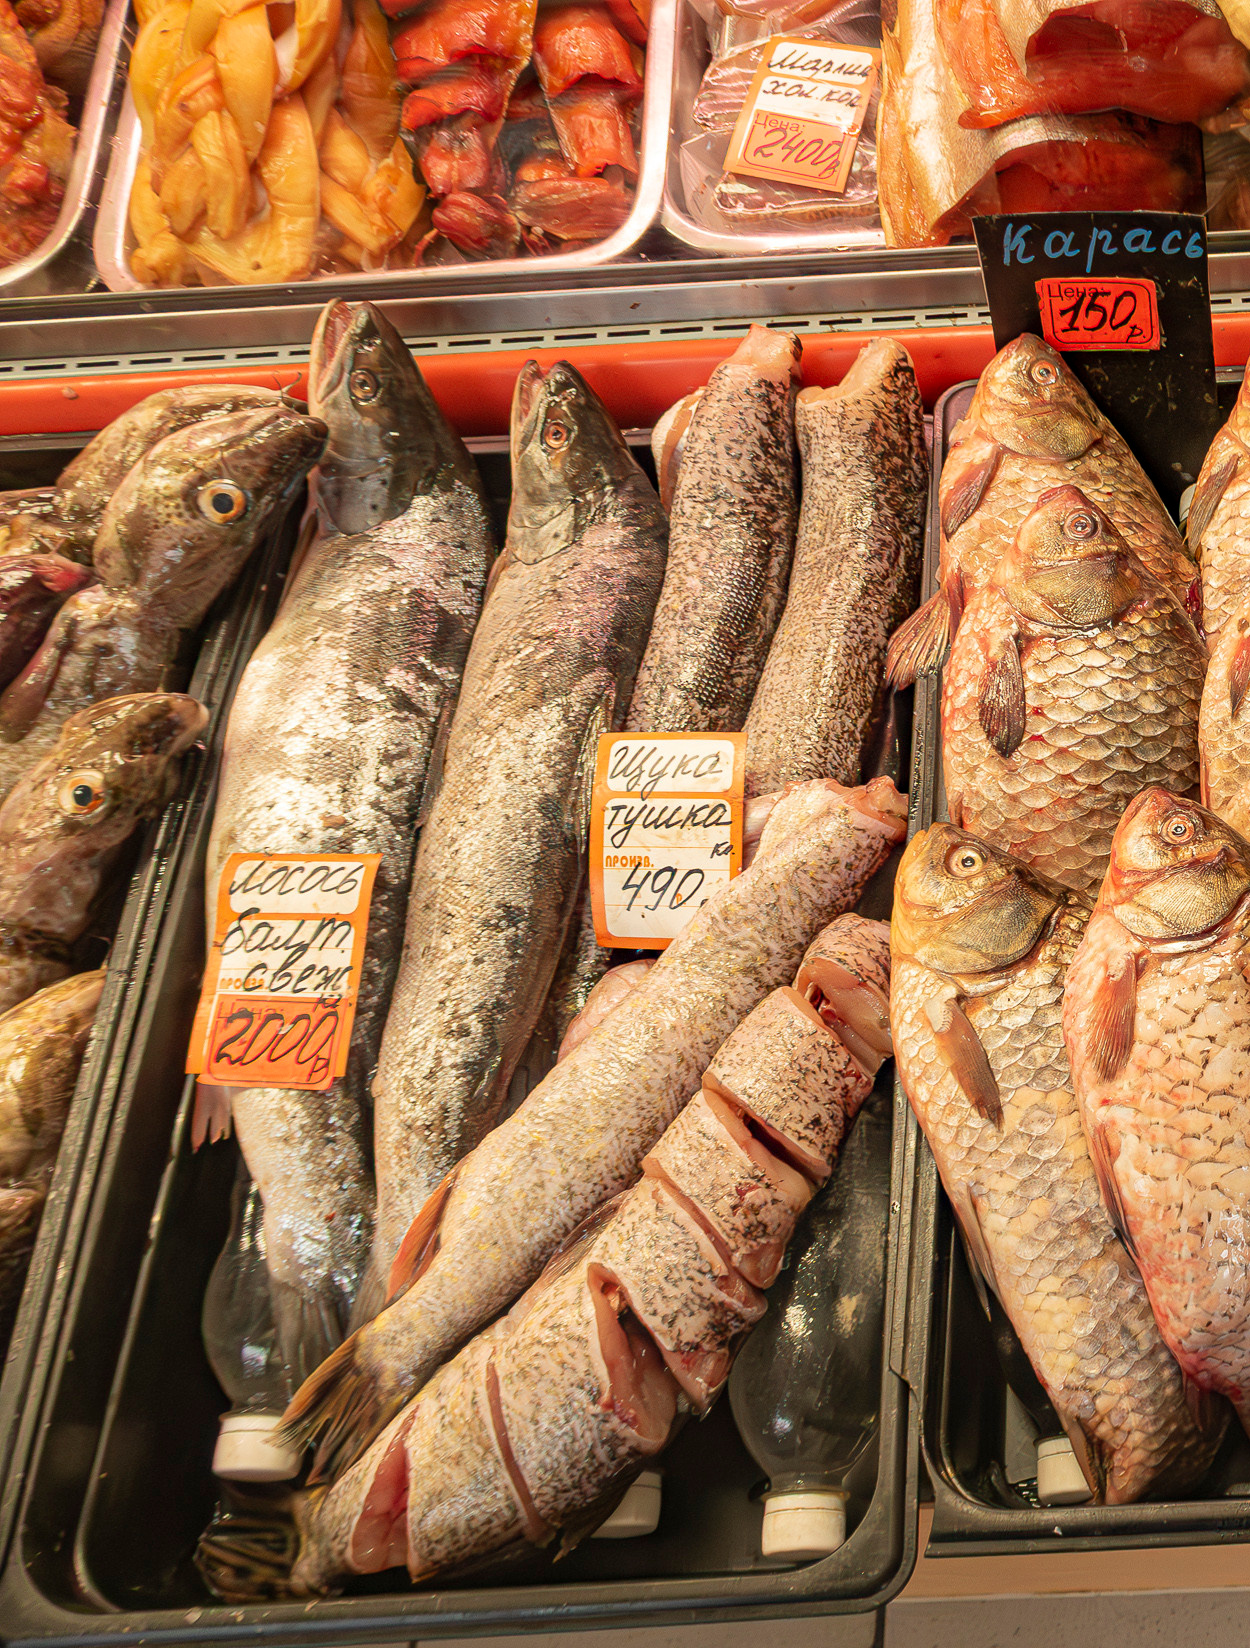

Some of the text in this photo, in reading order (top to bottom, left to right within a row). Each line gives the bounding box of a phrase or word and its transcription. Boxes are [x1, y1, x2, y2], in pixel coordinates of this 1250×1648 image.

[754, 112, 806, 134] Цена:
[1003, 222, 1204, 273] Карась
[1059, 290, 1137, 333] 150
[609, 745, 723, 802] Щука
